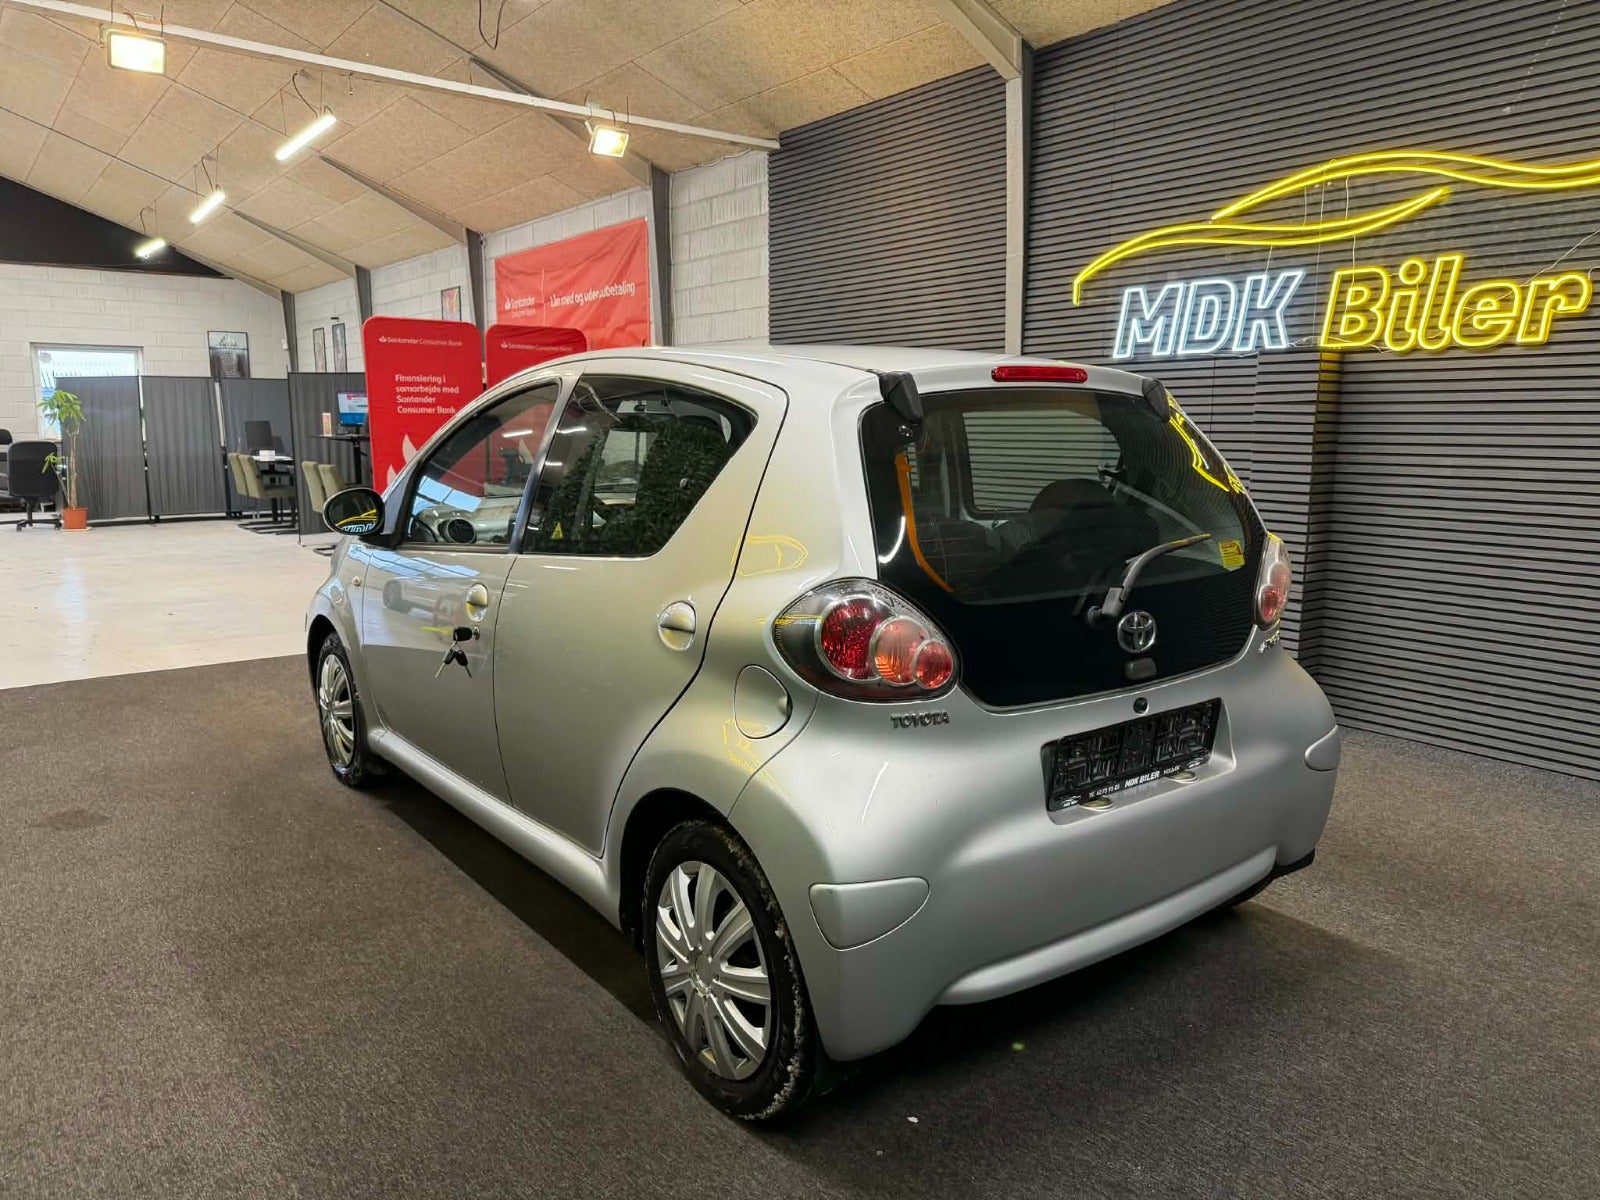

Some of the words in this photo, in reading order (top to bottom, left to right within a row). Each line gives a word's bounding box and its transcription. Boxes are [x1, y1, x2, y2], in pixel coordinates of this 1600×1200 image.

[1112, 268, 1305, 360] MDK
[1318, 252, 1593, 353] Biler
[387, 337, 419, 345] Santander
[420, 338, 447, 347] Consumer
[395, 374, 441, 385] Finansiering
[395, 385, 441, 395] samarbejde
[442, 386, 459, 394] med
[396, 395, 436, 404] Santander
[397, 405, 436, 414] Consumer
[437, 406, 456, 414] Bank
[890, 711, 950, 729] TOYOTA
[1124, 776, 1140, 788] MDK
[1139, 769, 1160, 784] BILER
